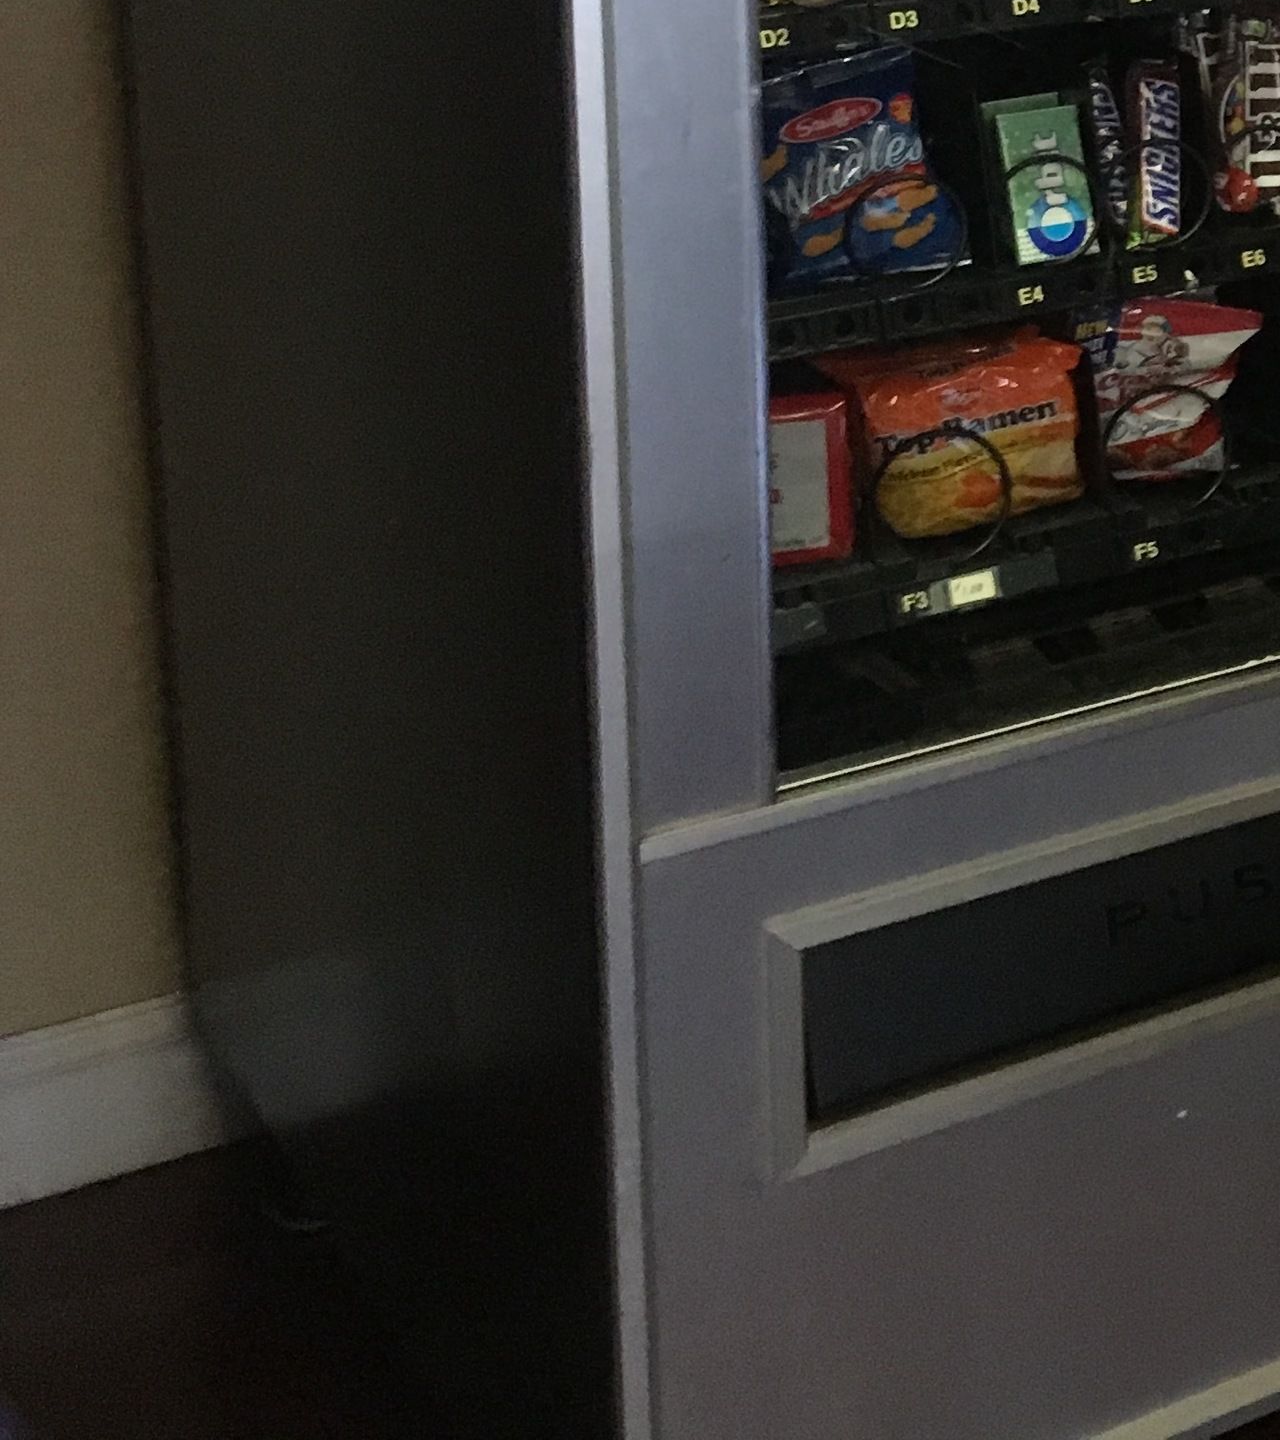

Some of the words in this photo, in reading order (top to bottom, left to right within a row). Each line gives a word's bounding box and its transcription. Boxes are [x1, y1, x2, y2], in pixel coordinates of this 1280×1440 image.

[889, 10, 919, 30] D3
[758, 27, 790, 49] D2
[1142, 83, 1180, 228] SNICERS
[1241, 248, 1266, 268] E6
[1132, 264, 1158, 284] E5
[1017, 285, 1045, 306] E4
[874, 427, 938, 465] Top
[941, 399, 1058, 436] Ramen
[1133, 541, 1159, 561] F5
[901, 590, 929, 613] F3
